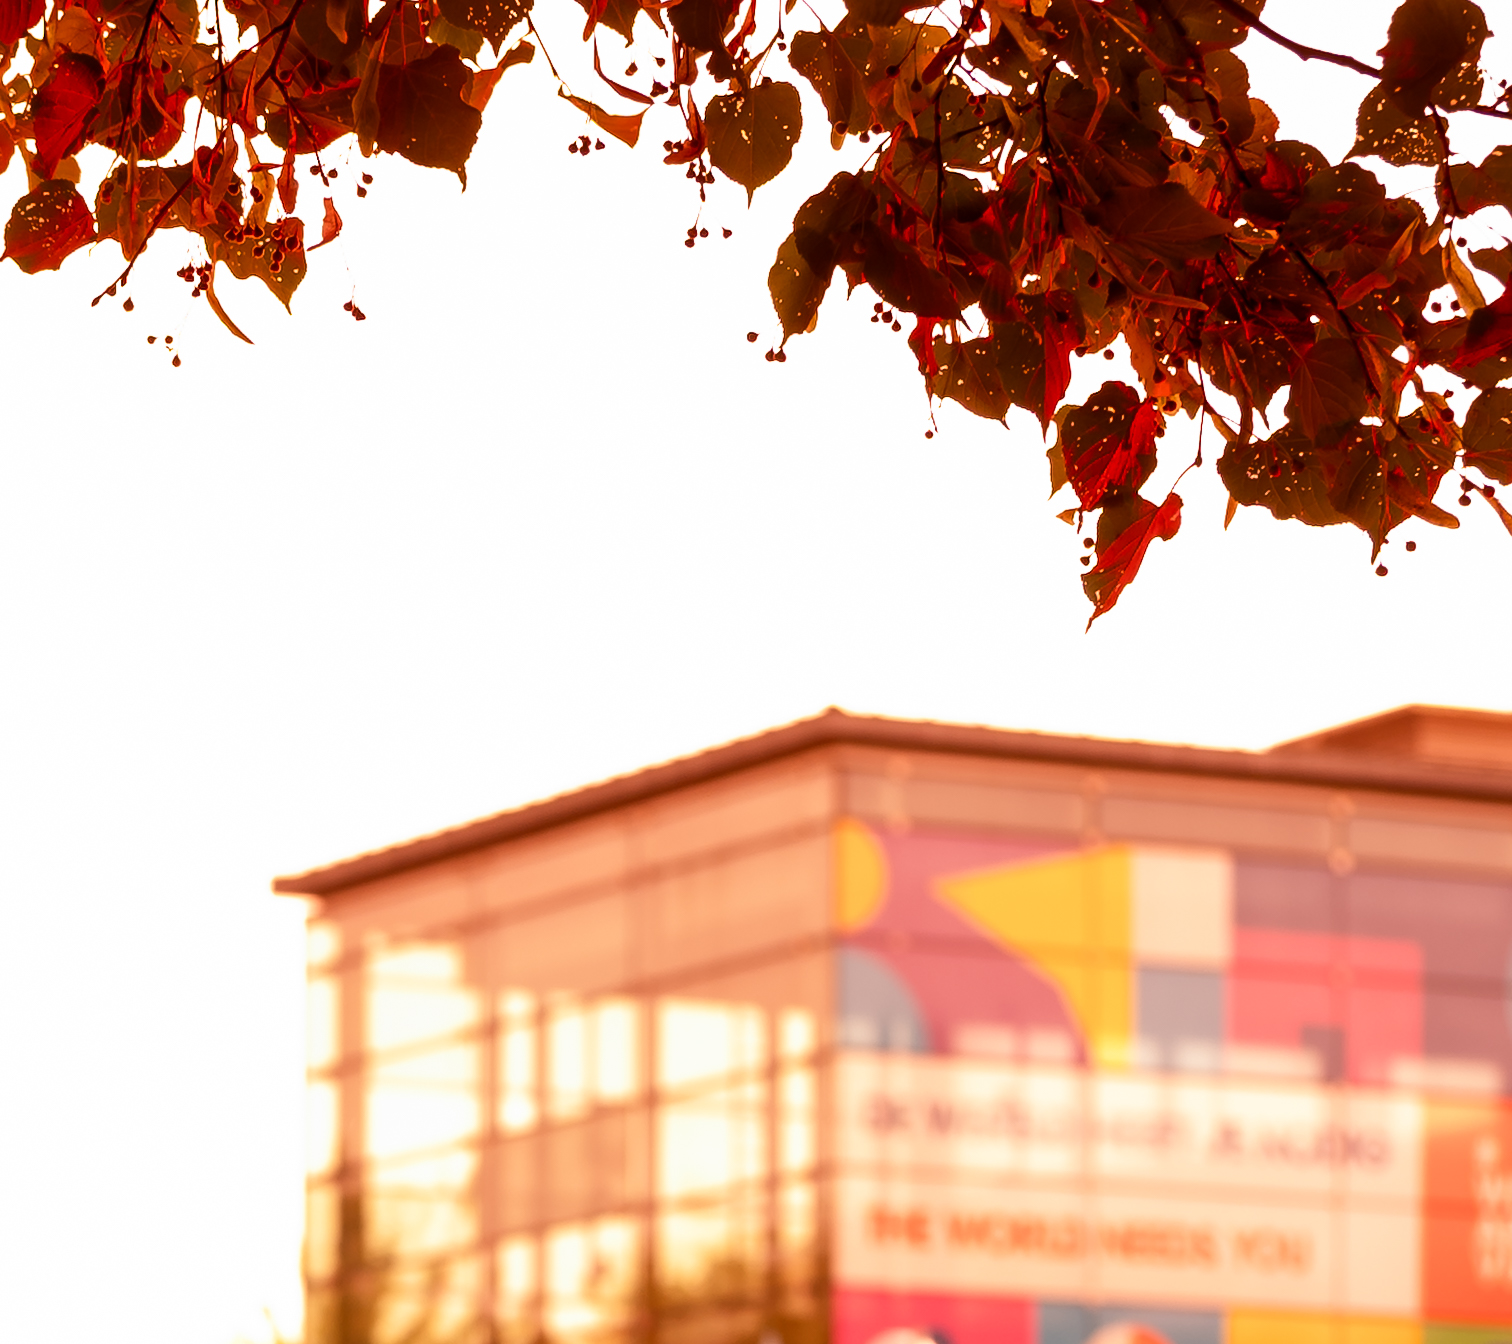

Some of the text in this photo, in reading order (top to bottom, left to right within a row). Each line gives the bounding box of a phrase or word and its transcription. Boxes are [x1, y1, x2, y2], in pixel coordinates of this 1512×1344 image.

[866, 1206, 1312, 1273] THE WORLD NEEDS YOU
